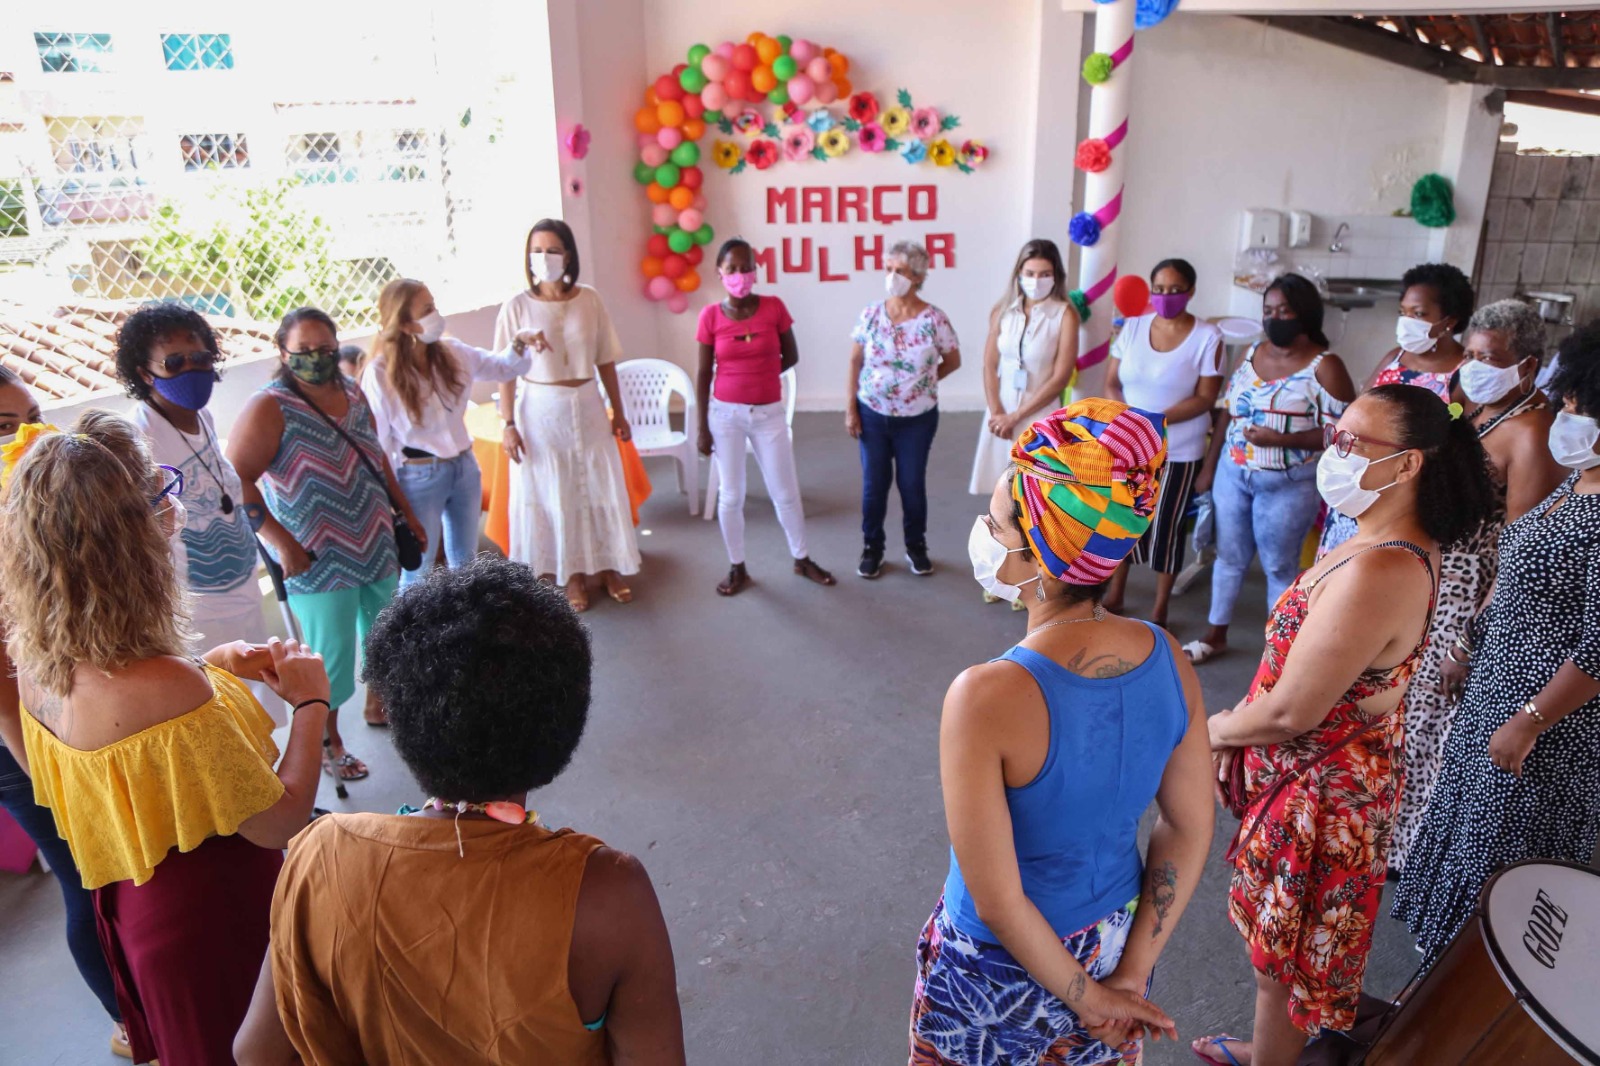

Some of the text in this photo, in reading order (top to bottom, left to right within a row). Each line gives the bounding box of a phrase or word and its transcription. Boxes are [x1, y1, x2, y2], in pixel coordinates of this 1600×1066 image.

[766, 184, 937, 224] MARÇO
[752, 233, 955, 283] MULHR
[1522, 888, 1568, 969] GOPE
